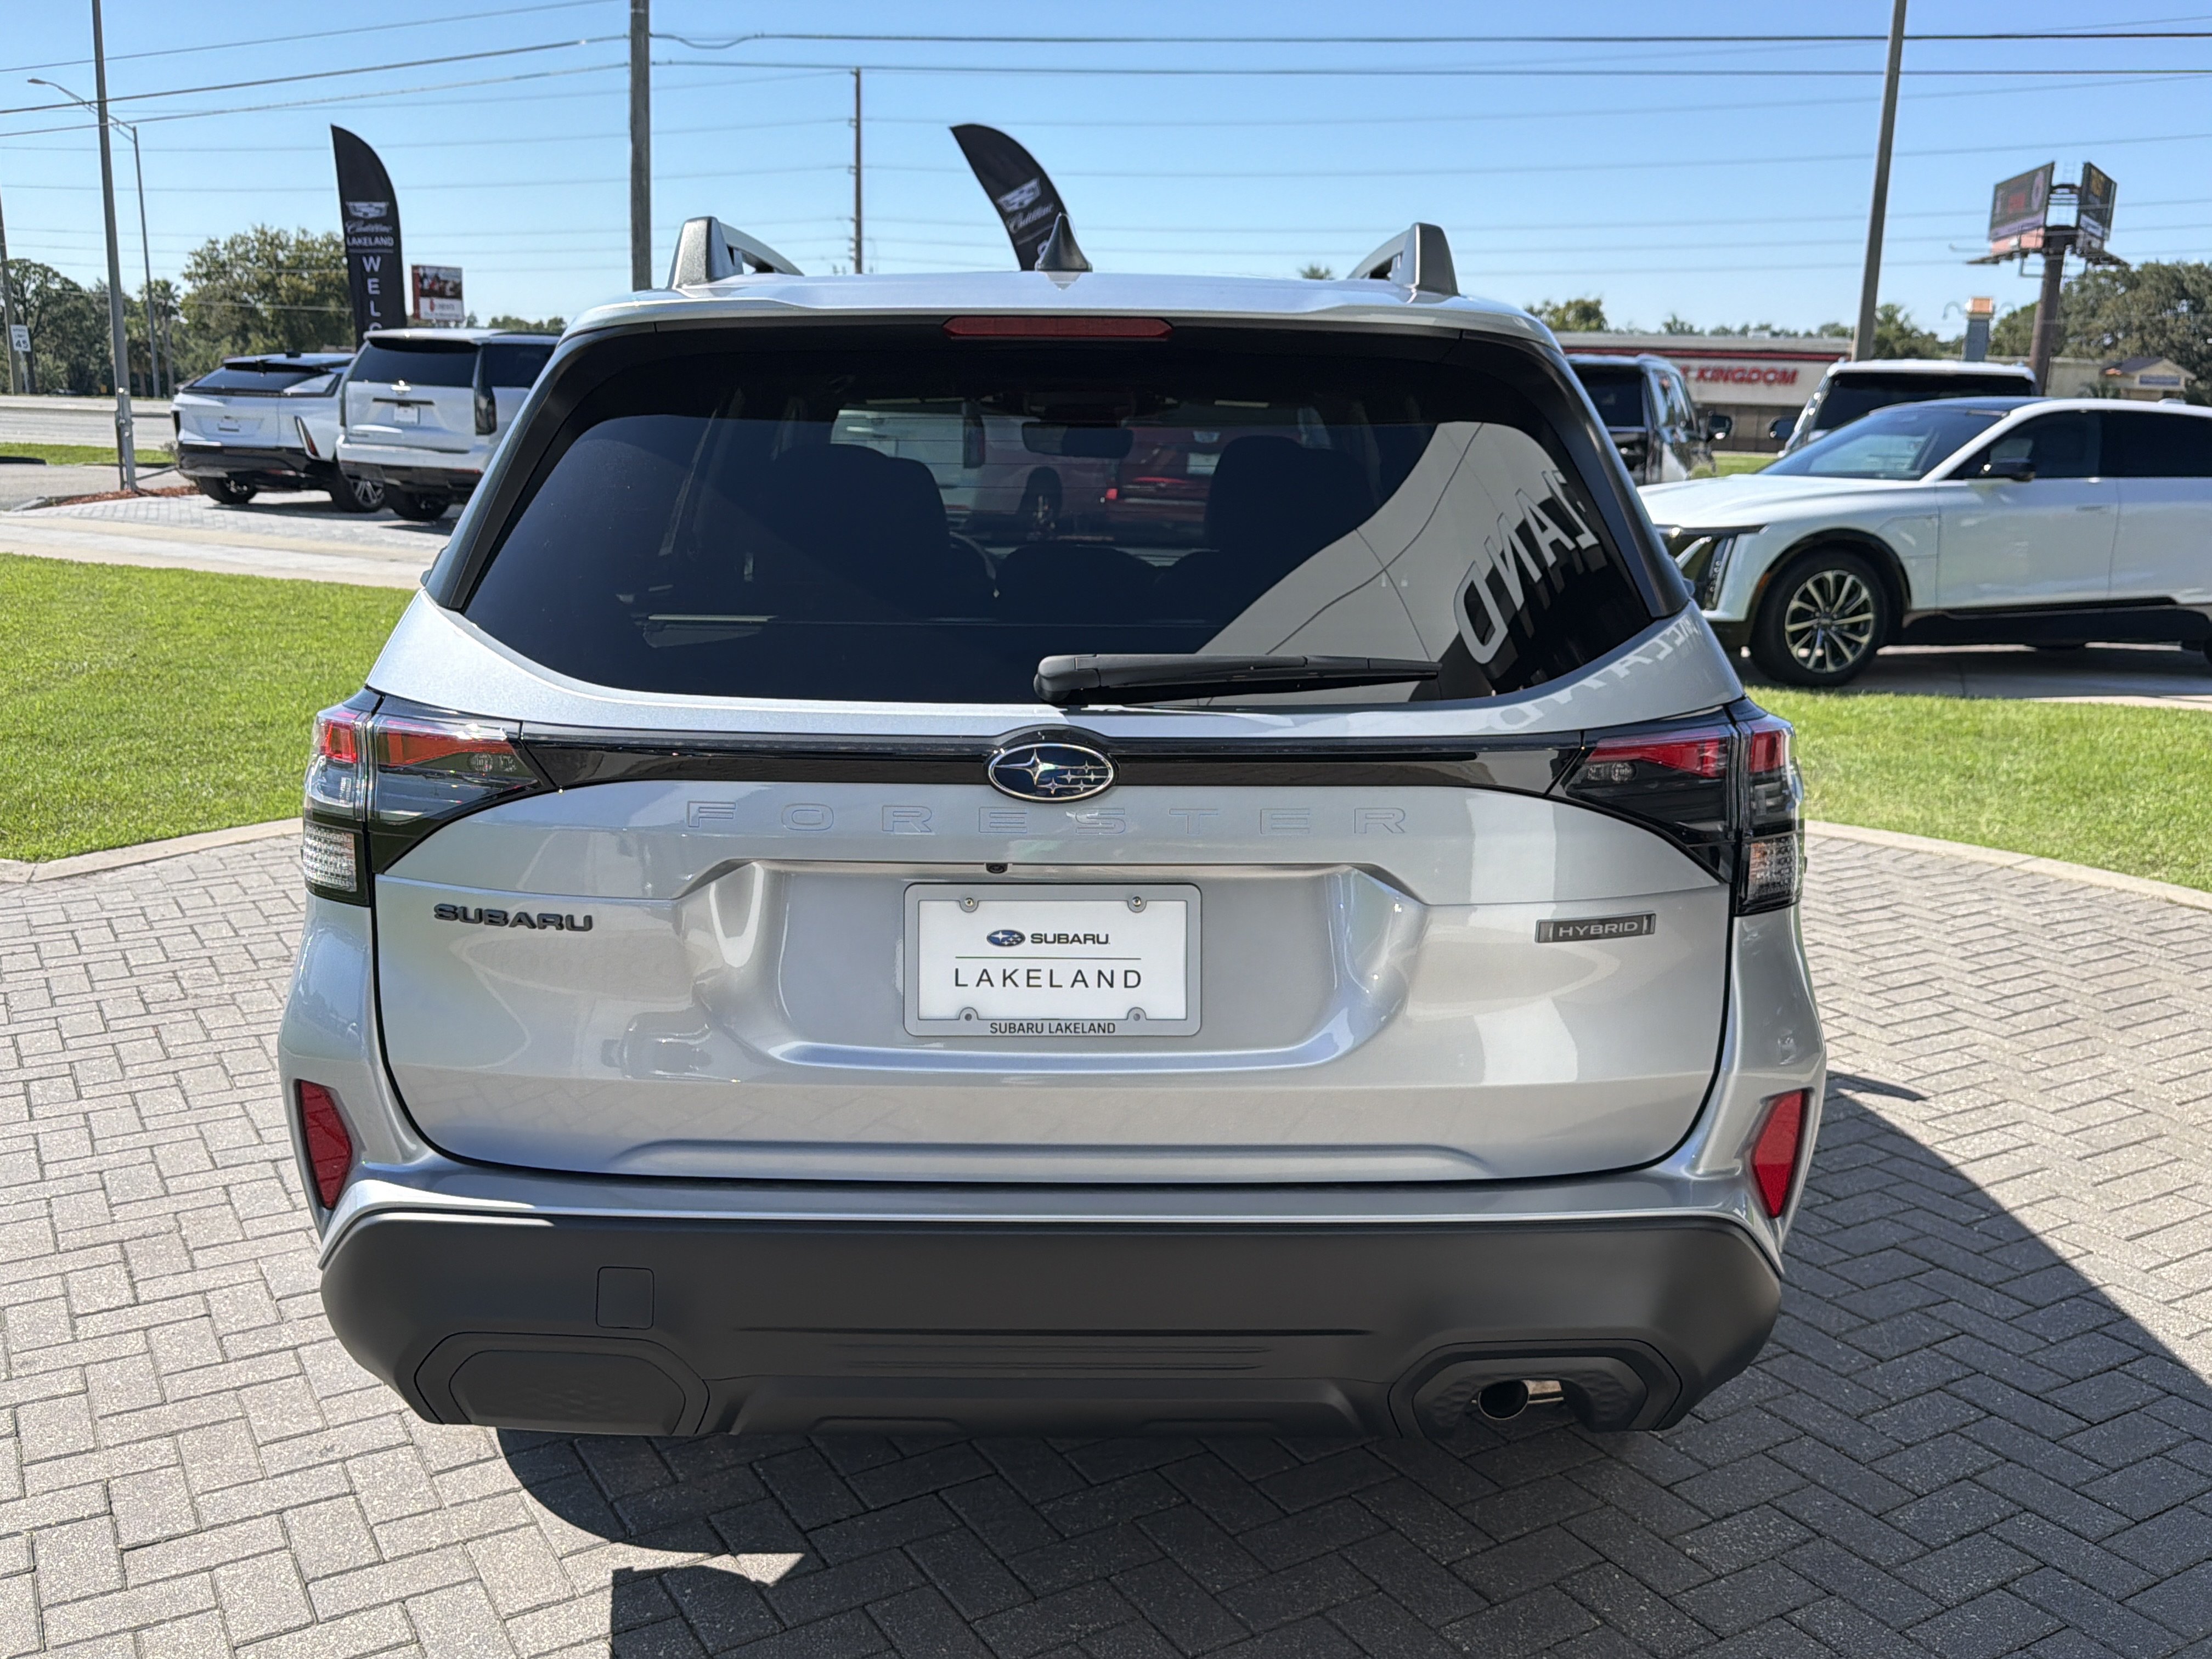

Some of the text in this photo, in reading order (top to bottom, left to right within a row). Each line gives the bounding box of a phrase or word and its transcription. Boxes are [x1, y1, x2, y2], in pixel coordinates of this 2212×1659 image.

[347, 236, 394, 247] LAKELAND
[15, 340, 29, 349] 45
[1696, 363, 1799, 386] KINGDOM
[686, 800, 1406, 835] FORESTER
[433, 903, 594, 932] SUBARU
[1558, 922, 1638, 938] HYBRID
[1030, 933, 1110, 945] SUBARU
[955, 968, 1142, 989] LAKELAND
[989, 1022, 1116, 1035] SUBARU LAKELAND
